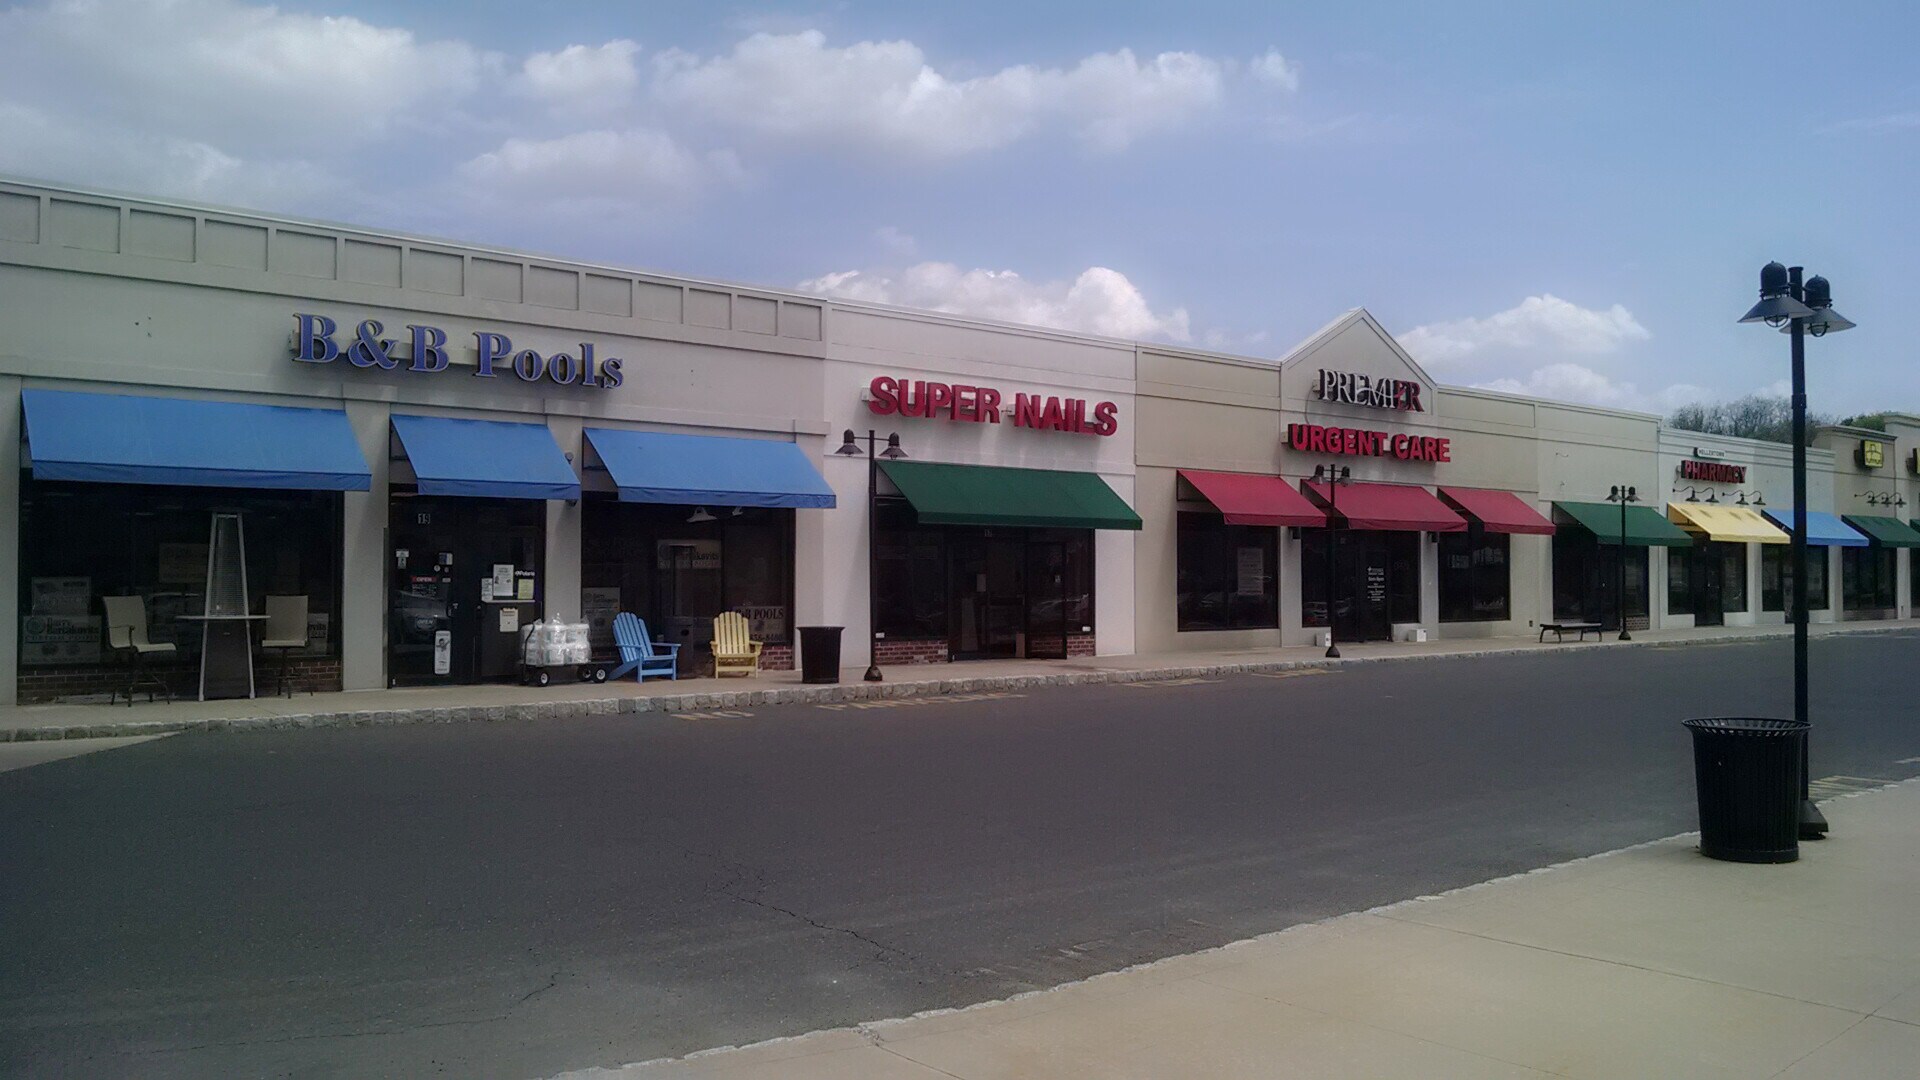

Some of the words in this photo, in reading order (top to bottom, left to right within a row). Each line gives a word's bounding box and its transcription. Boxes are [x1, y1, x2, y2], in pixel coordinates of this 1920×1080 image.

[292, 313, 450, 370] B&B
[473, 331, 624, 390] Pools
[868, 376, 1001, 424] SUPER
[1013, 393, 1118, 437] NAILS
[1318, 369, 1425, 413] PREMIER
[1288, 423, 1388, 457] URGENT
[1391, 433, 1451, 463] CARE
[1683, 460, 1746, 483] PHARMACY
[418, 513, 431, 525] 19
[754, 607, 784, 620] POOLS
